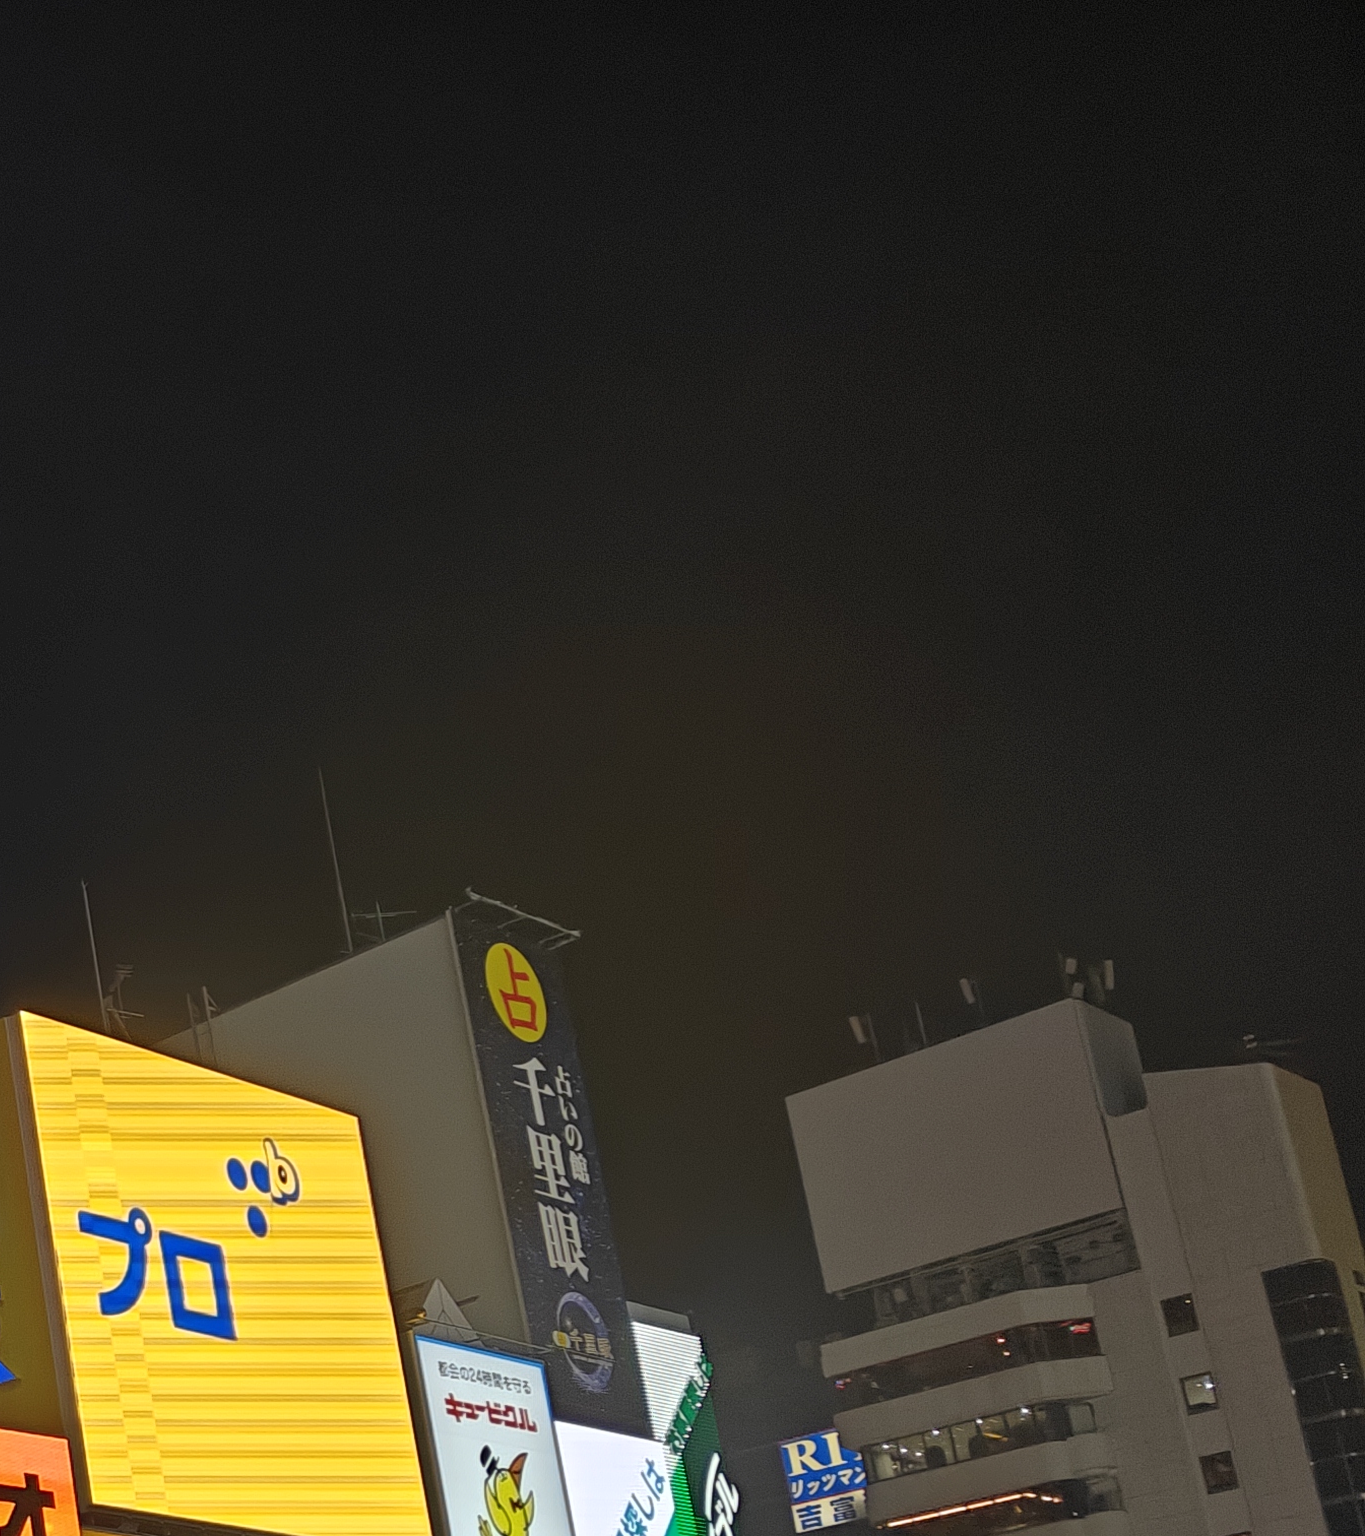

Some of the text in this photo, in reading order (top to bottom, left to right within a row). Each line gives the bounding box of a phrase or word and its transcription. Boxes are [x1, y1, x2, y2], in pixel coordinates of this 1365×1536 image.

[498, 948, 538, 1031] 占
[513, 1057, 589, 1282] 千里眼
[554, 1064, 590, 1184] 占いの館
[78, 1206, 239, 1341] プロ
